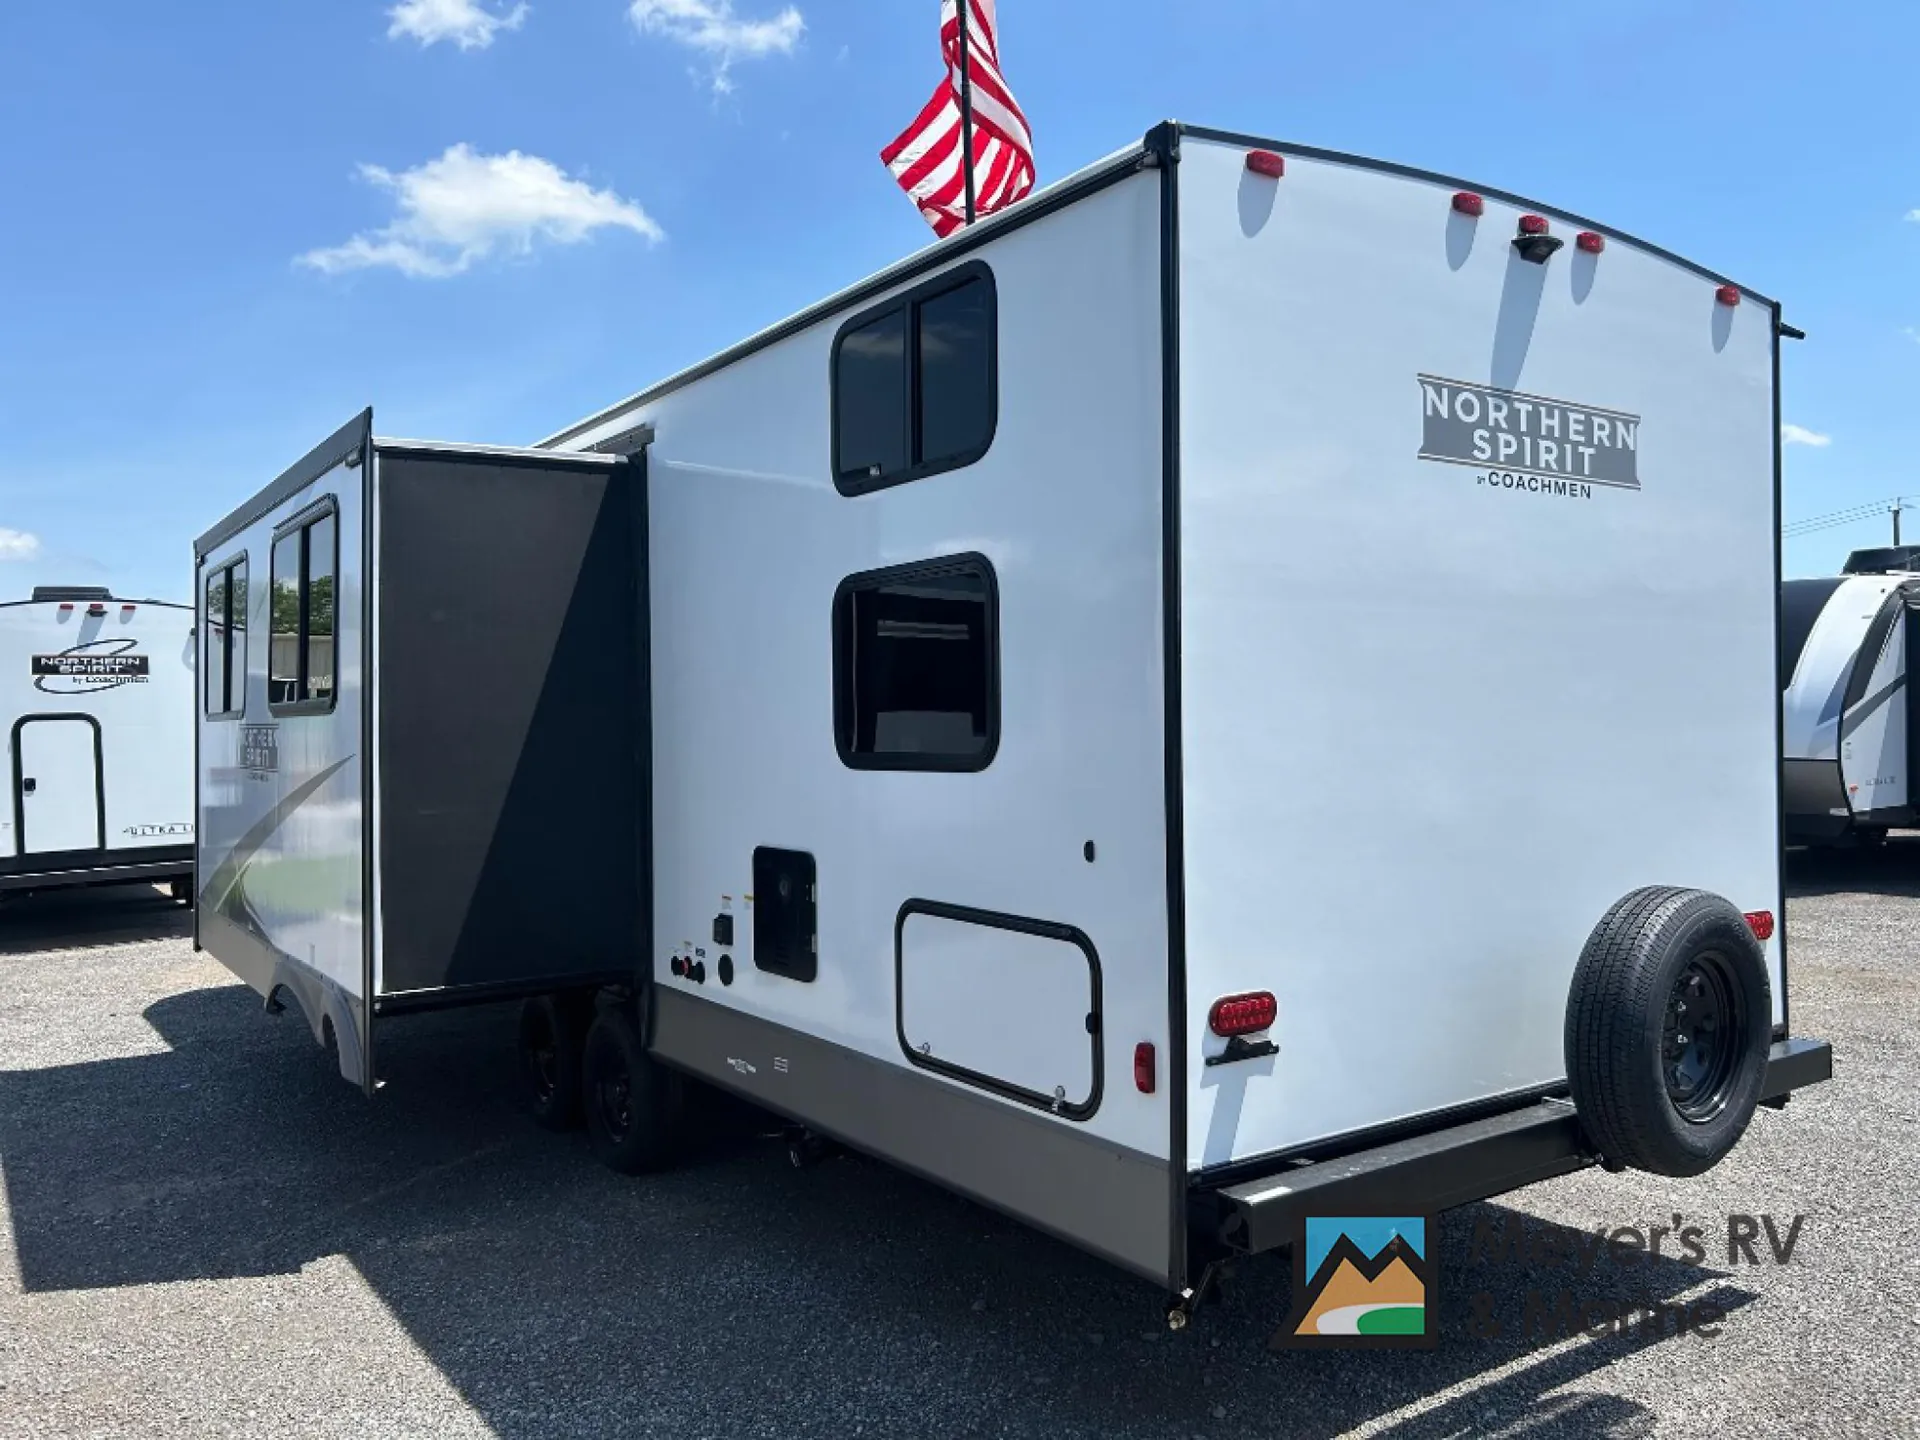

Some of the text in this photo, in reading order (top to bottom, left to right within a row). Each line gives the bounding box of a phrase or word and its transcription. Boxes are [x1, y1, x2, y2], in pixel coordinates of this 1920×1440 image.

[1423, 383, 1636, 452] NORTHERN
[1471, 428, 1598, 476] SPIRIT
[1488, 471, 1591, 499] COACHMEN
[40, 657, 140, 665] NORTHERN
[59, 665, 123, 674] SPIRIT
